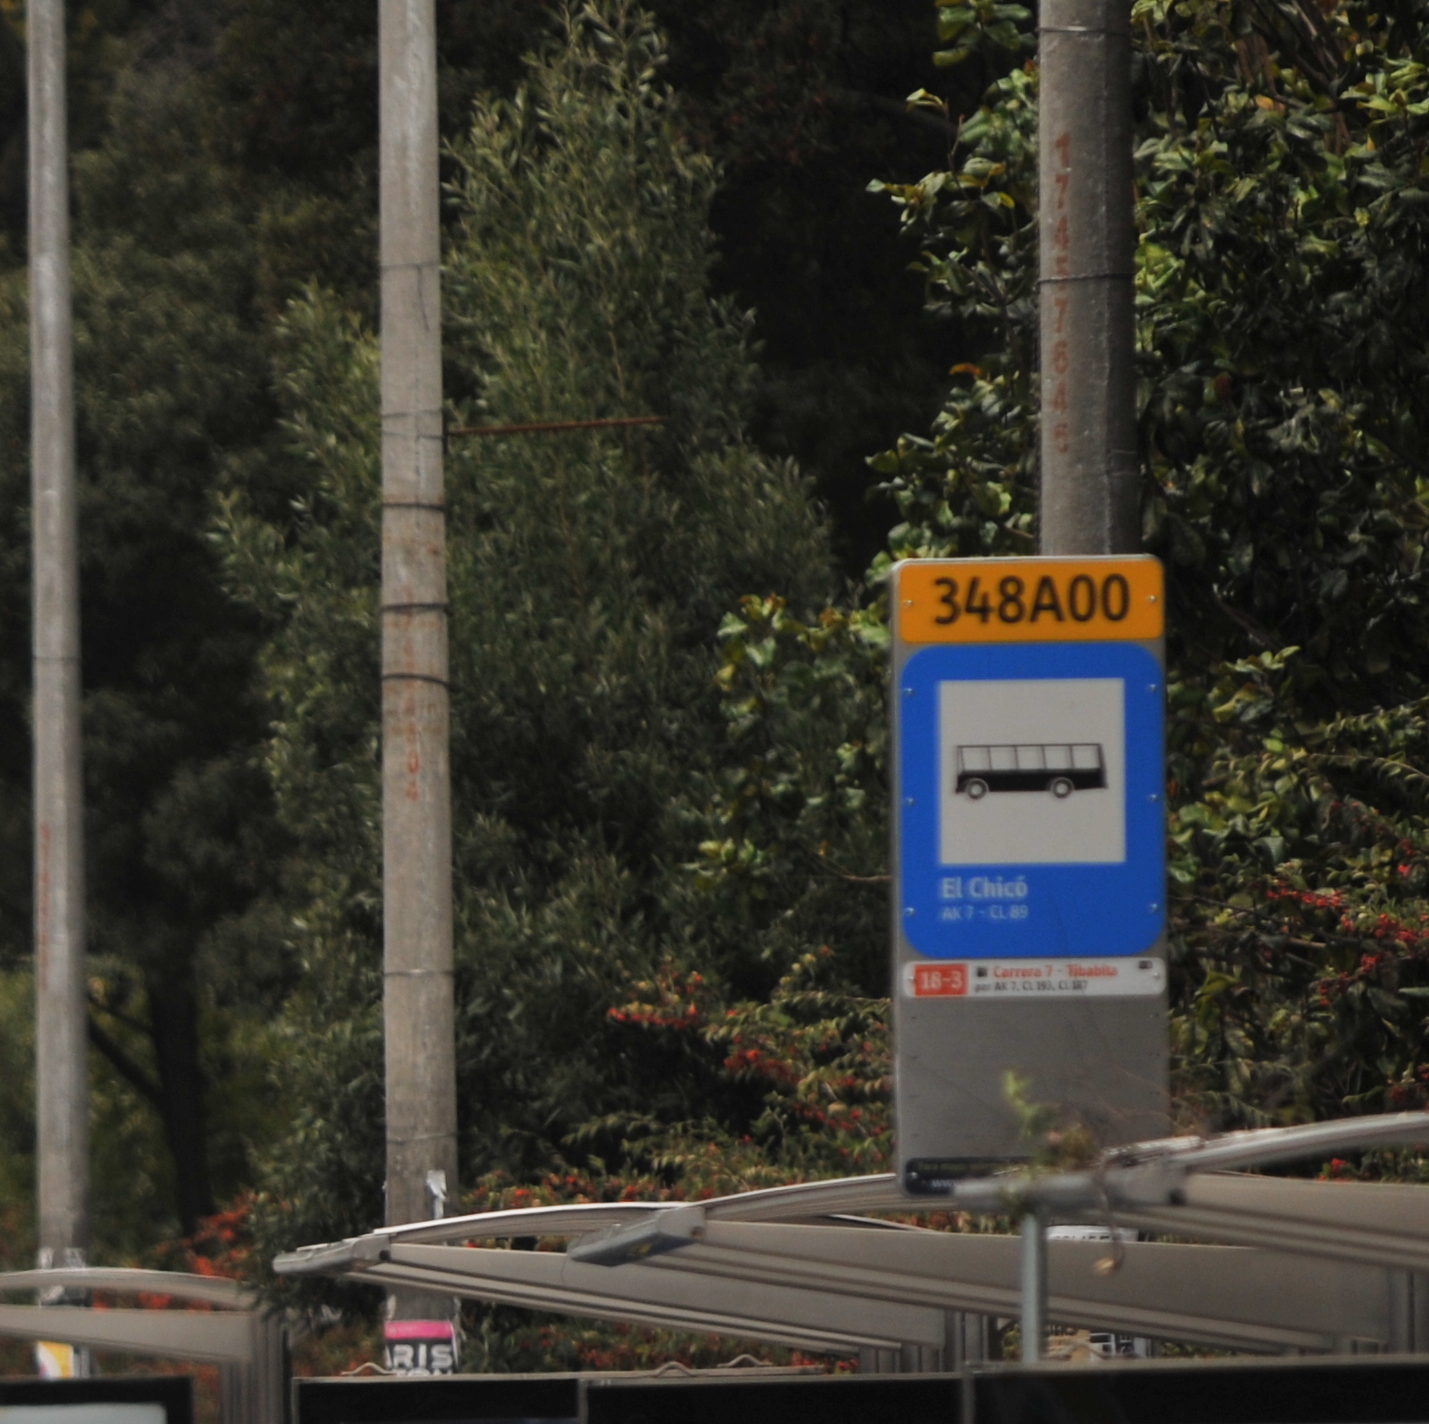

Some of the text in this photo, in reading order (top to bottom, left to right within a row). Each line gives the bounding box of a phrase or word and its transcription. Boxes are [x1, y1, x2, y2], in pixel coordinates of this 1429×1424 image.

[932, 573, 1131, 627] 348A00
[941, 875, 1028, 898] El Chicó
[942, 905, 961, 920] AK
[966, 905, 974, 919] 7
[991, 905, 1005, 919] CL
[920, 970, 963, 991] 18-3
[993, 966, 1043, 978] Carrera
[1045, 966, 1053, 977] 7
[387, 1344, 453, 1368] RIS
